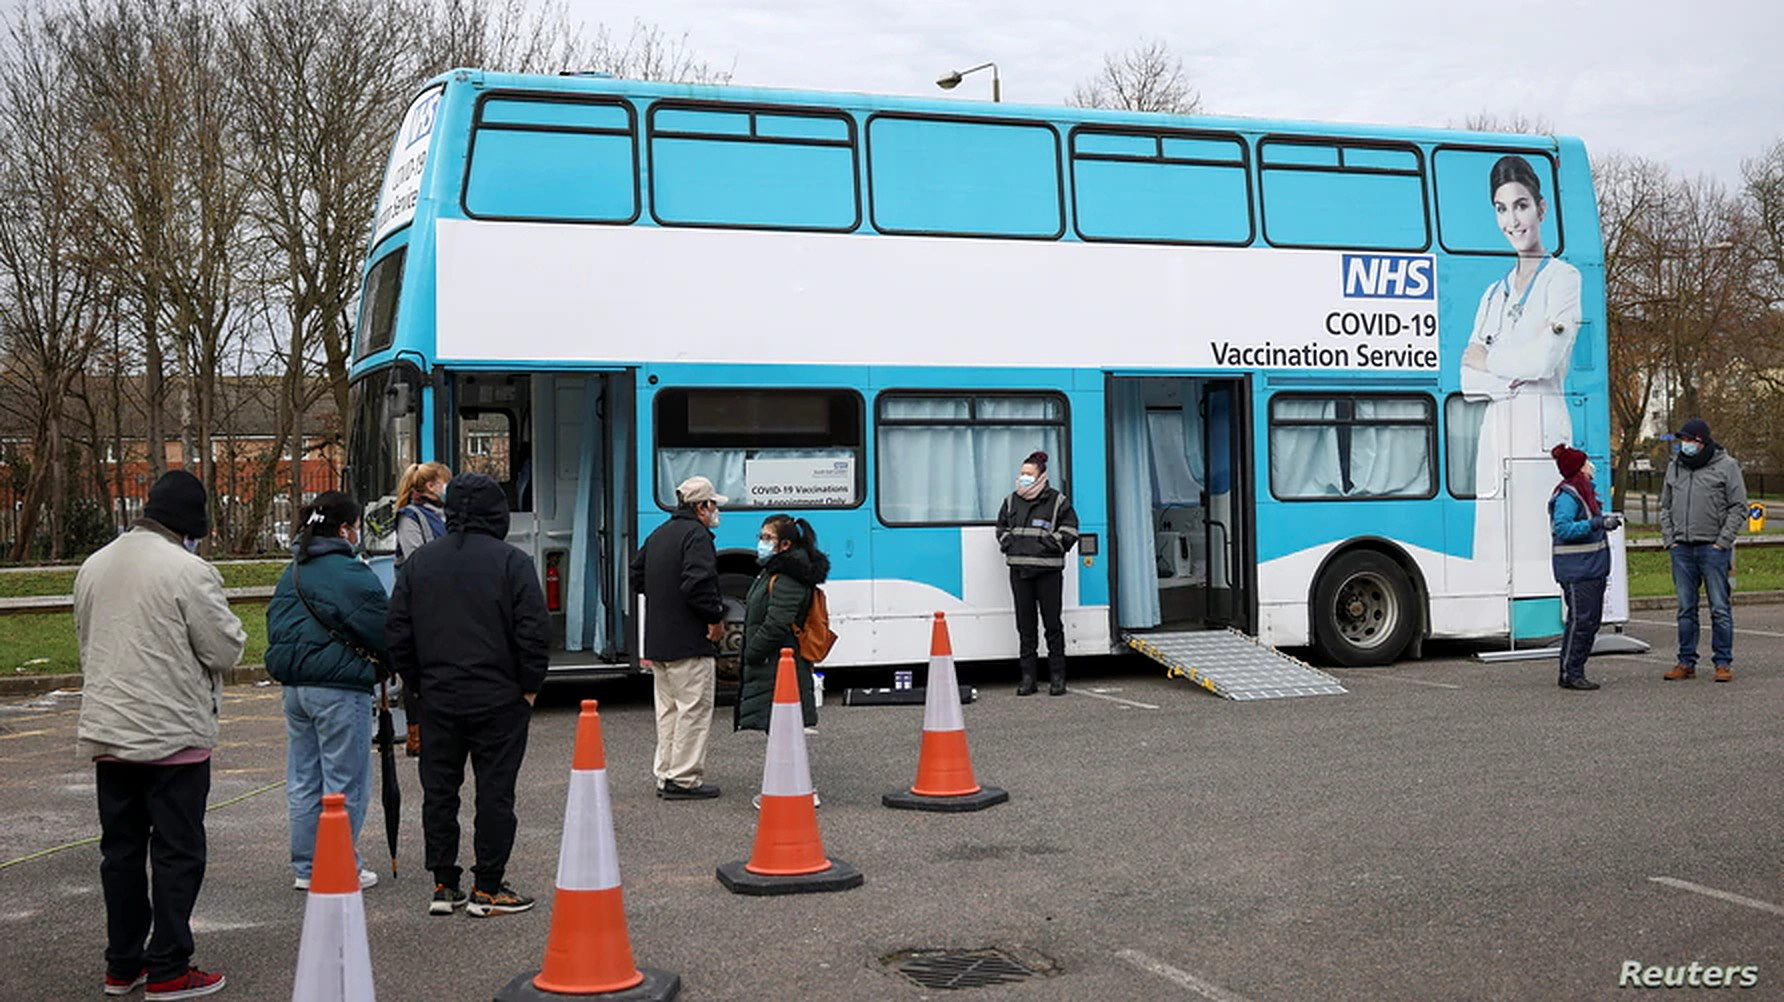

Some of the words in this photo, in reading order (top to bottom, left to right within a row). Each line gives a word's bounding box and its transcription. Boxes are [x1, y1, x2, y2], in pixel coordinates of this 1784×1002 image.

[1345, 257, 1431, 297] NHS
[1325, 311, 1437, 337] COVID-19
[1211, 341, 1349, 367] Vaccination
[1356, 343, 1438, 368] Service
[751, 485, 794, 496] COVID-19
[795, 484, 849, 495] Vaccinations
